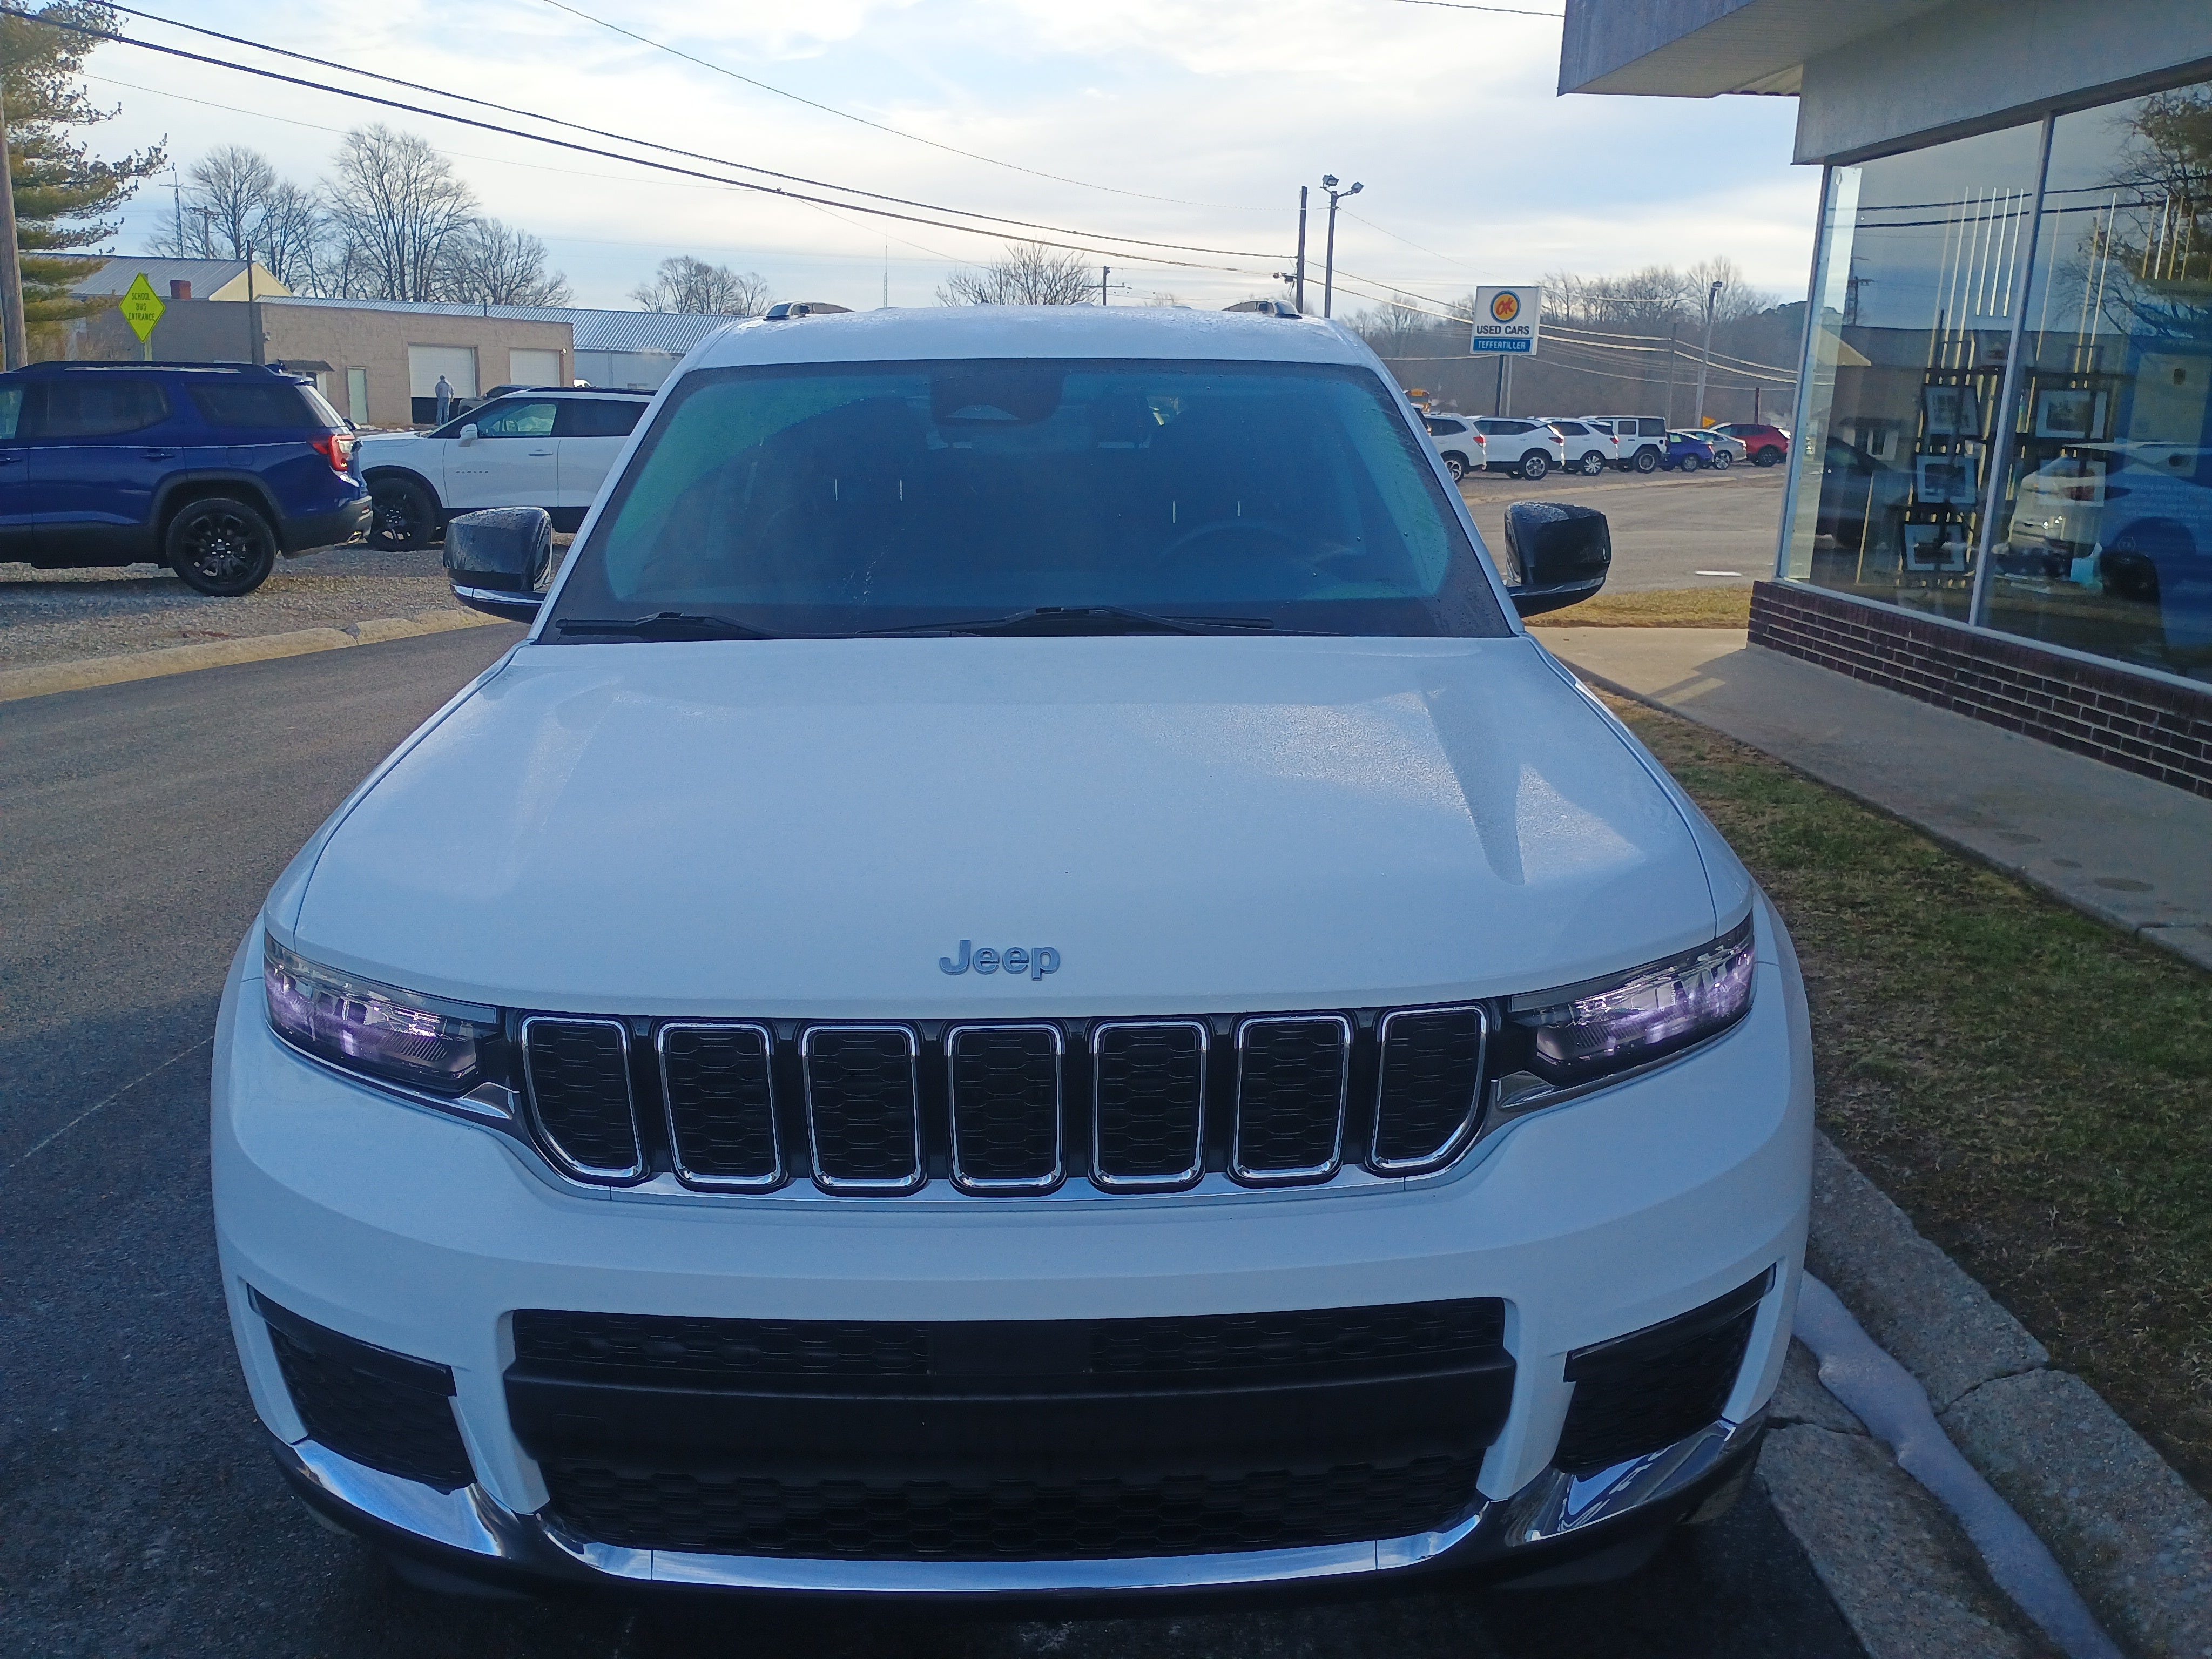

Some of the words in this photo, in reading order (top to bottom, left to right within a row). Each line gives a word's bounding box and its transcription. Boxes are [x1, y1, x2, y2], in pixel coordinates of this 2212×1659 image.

[131, 292, 151, 300] SCHOOL
[136, 302, 147, 311] BUS
[1495, 297, 1515, 315] OK
[128, 312, 156, 321] ENTRANCE
[1476, 325, 1502, 334] USED
[1505, 325, 1530, 335] CARS
[1478, 340, 1526, 349] TEFFERTILLER
[939, 939, 1061, 981] Jeep
